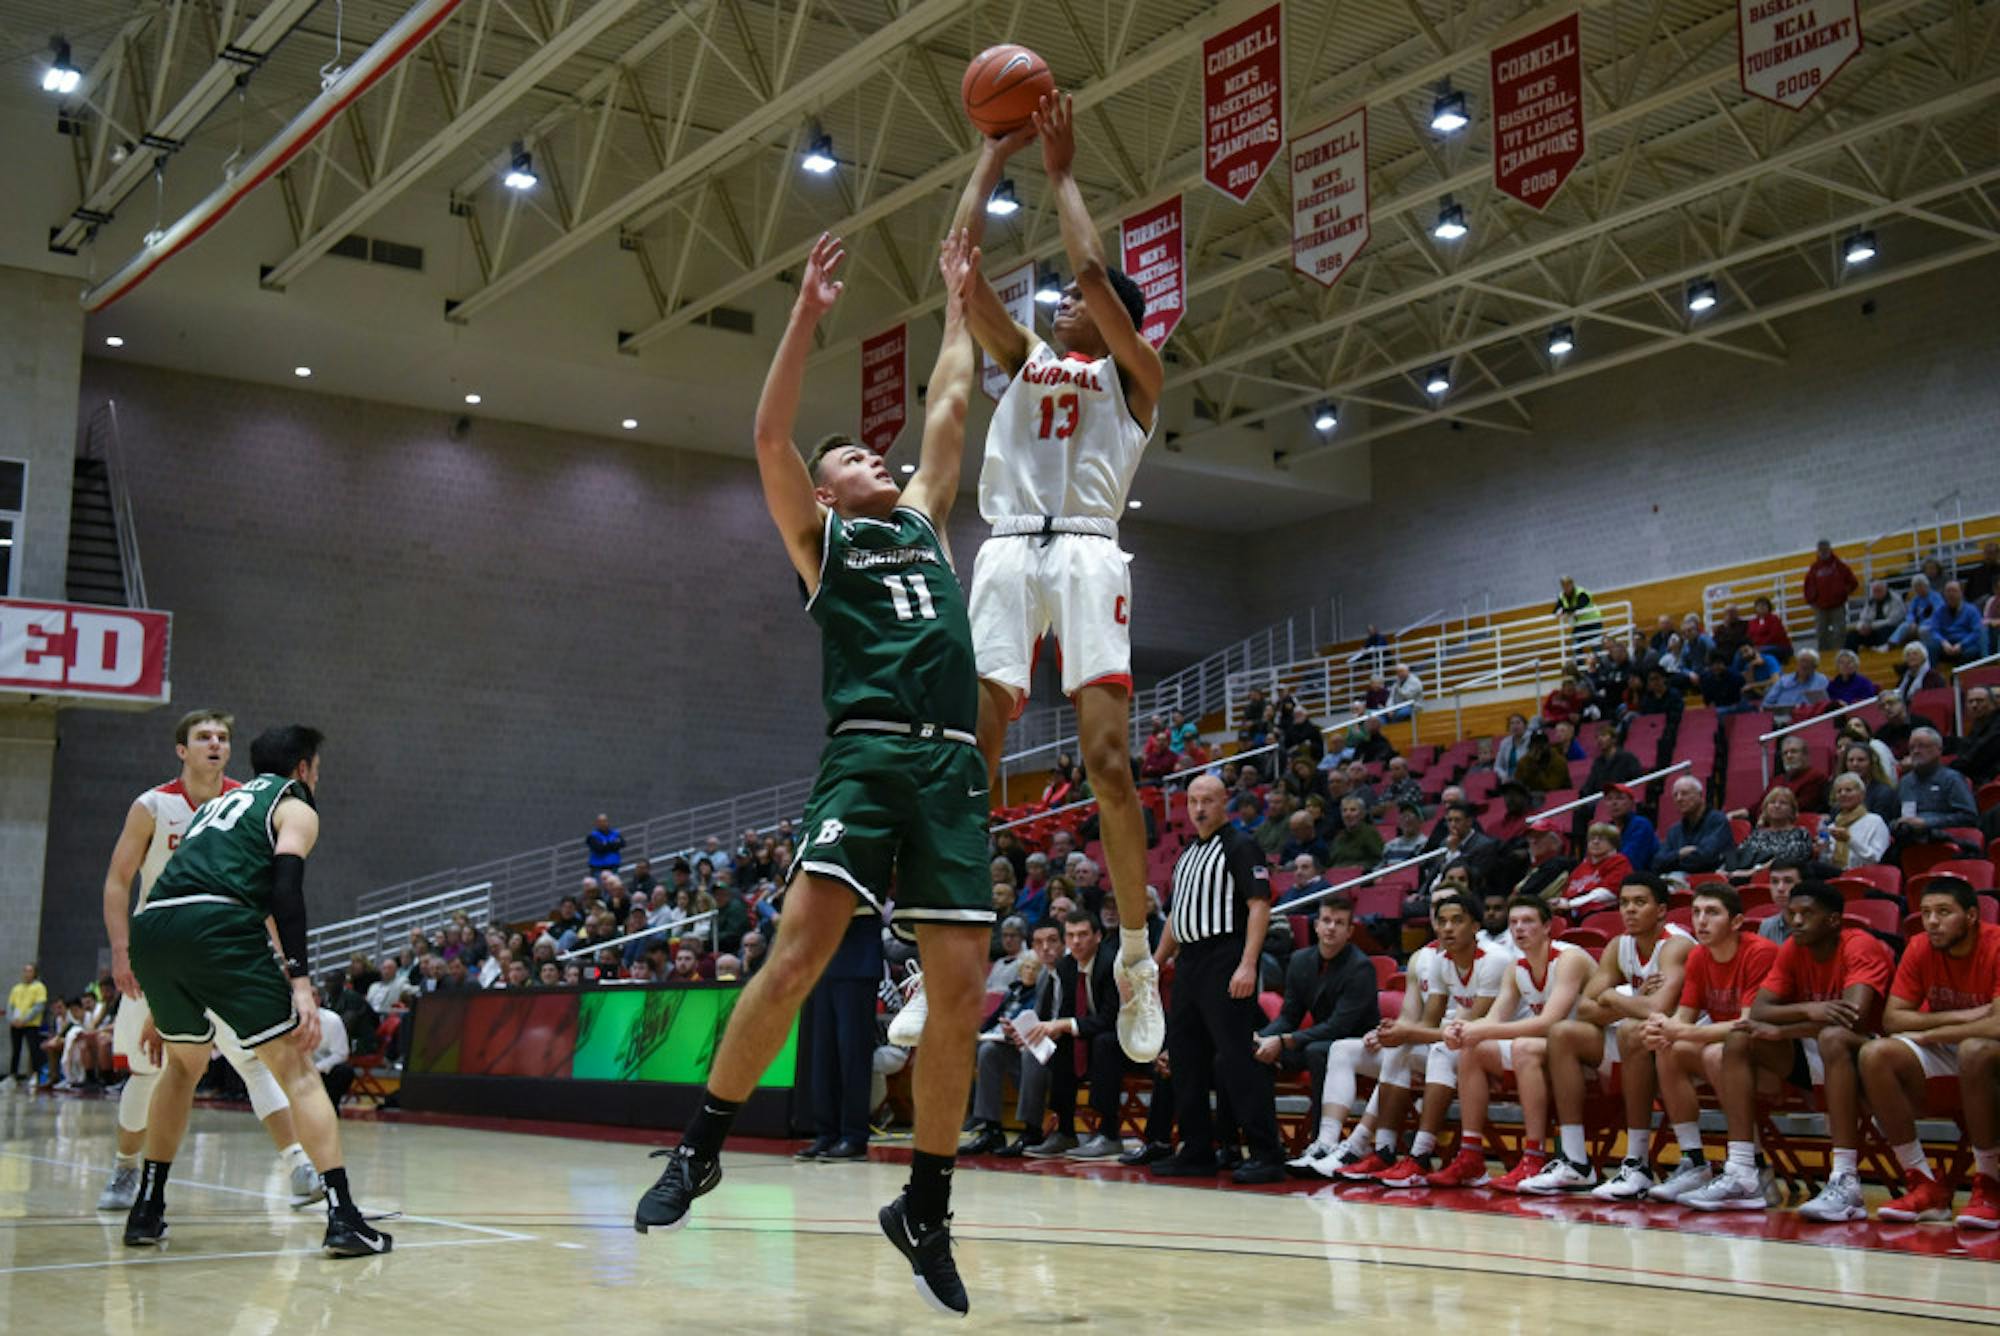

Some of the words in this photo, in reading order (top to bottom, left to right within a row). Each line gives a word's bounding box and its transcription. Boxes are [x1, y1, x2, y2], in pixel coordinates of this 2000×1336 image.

[1750, 0, 1813, 23] BASKE
[1774, 9, 1816, 41] NCAA
[1207, 24, 1277, 75] CORNELL
[1498, 35, 1575, 84] CORNELL
[1746, 16, 1852, 75] TOURNAMENT
[1225, 65, 1260, 96] MEN'S
[1518, 75, 1557, 103] MEN'S
[1776, 67, 1821, 99] 2008
[1211, 121, 1229, 143] IVY
[1231, 99, 1273, 135] LEAGUE
[1503, 128, 1523, 149] IVY
[1527, 108, 1574, 142] LEAGUE
[1209, 117, 1279, 169] CHAMPIONS
[1295, 131, 1360, 172] CORNELL
[1501, 128, 1577, 176] CHAMPIONS
[1228, 161, 1259, 189] 2010
[1521, 169, 1557, 197] 2008
[1127, 211, 1179, 249] CORNELL
[1294, 213, 1364, 252] TOURNAMENT
[1313, 205, 1341, 228] NCAA
[1039, 394, 1079, 440] 13
[883, 574, 937, 621] 11
[1114, 594, 1128, 625] C
[814, 818, 846, 847] B
